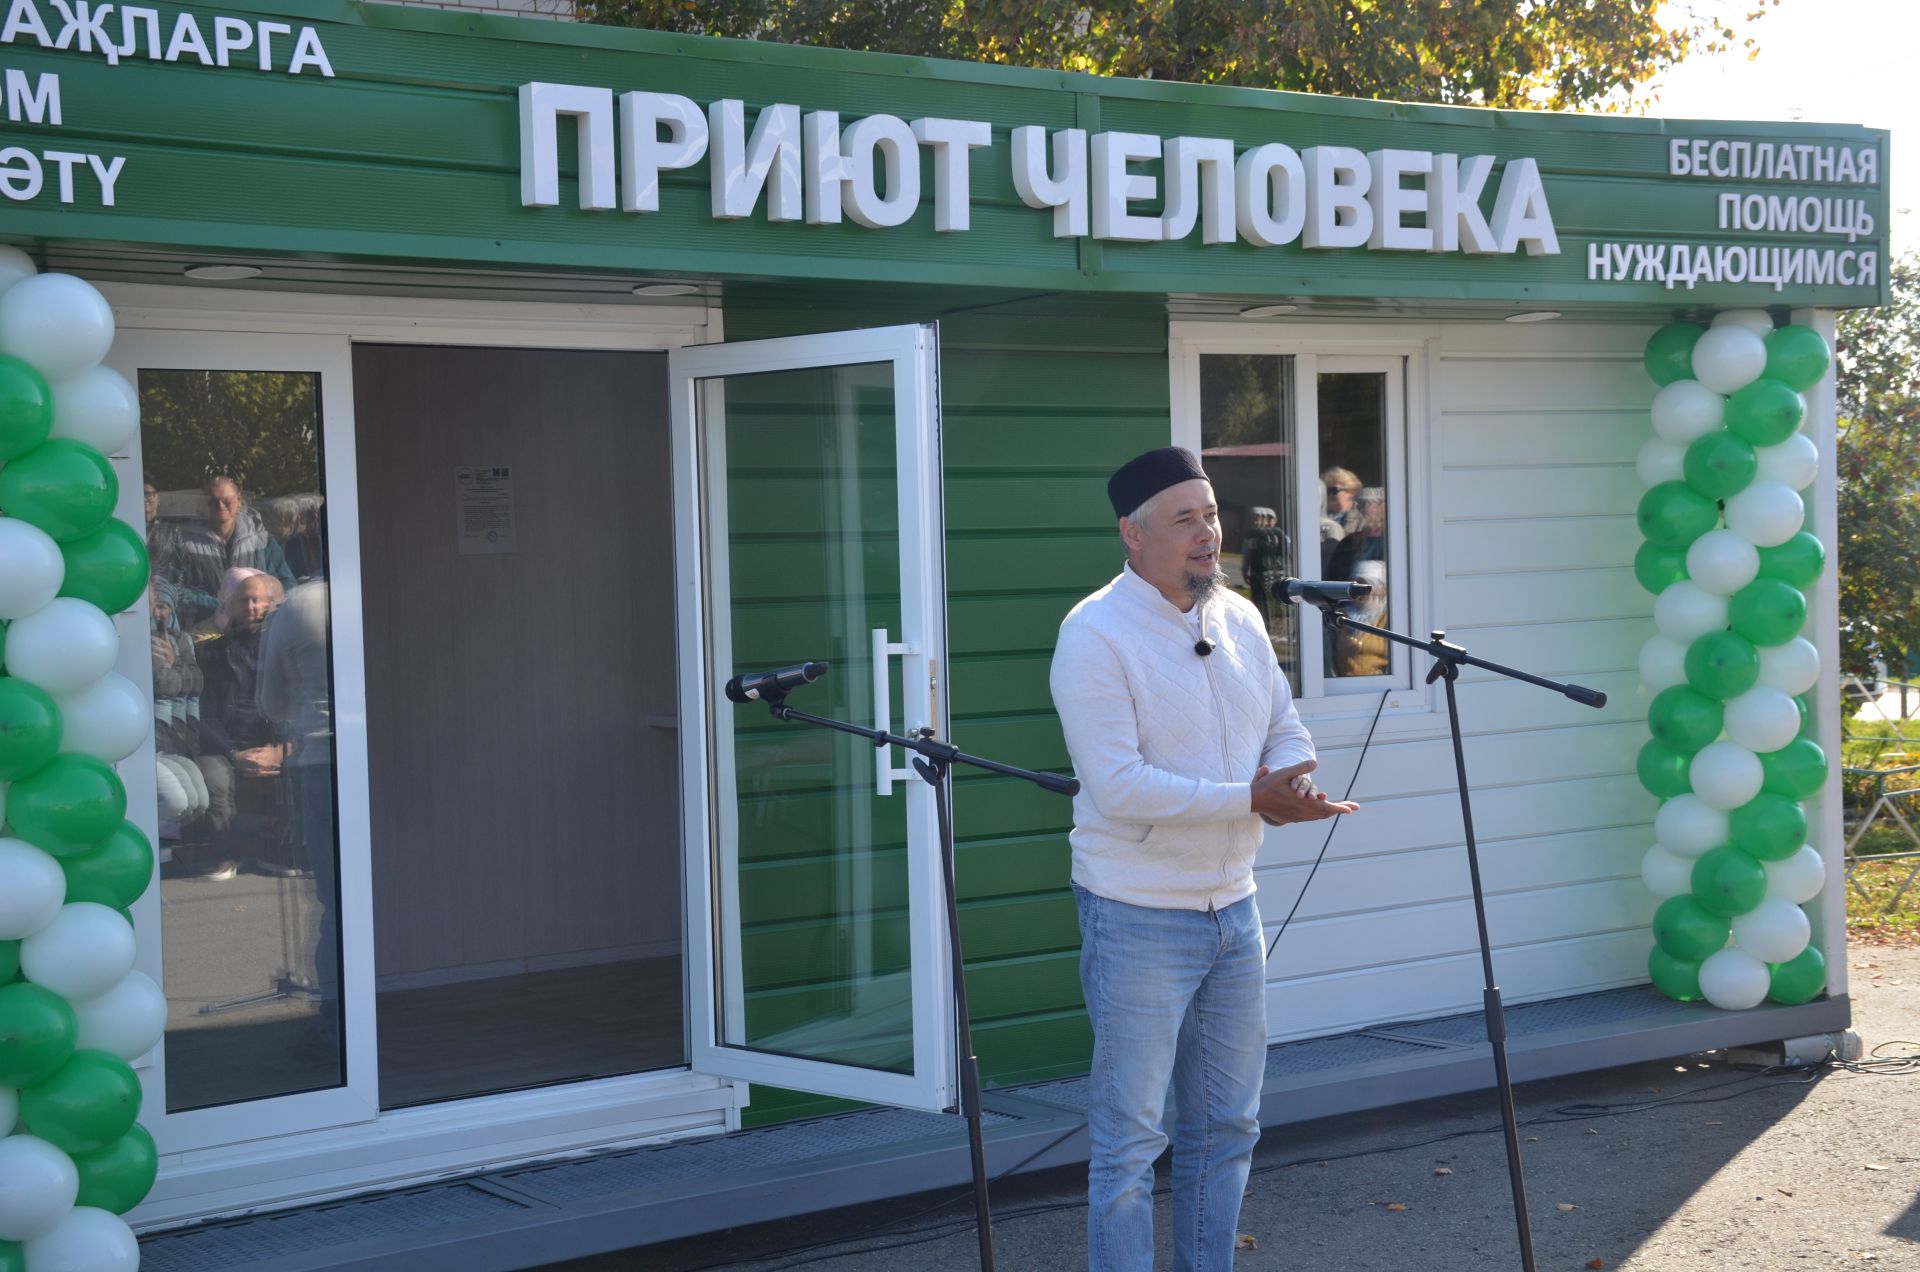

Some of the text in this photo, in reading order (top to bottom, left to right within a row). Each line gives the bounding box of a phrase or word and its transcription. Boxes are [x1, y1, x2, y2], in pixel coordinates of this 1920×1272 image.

[518, 81, 1561, 256] ПРИЮТ ЧЕЛОВЕКА
[1669, 138, 1877, 184] БЕСПЛАТНАЯ
[1718, 192, 1874, 242] ПОМОЩЬ
[1587, 243, 1877, 291] НУЖДАЮЩИМСЯ
